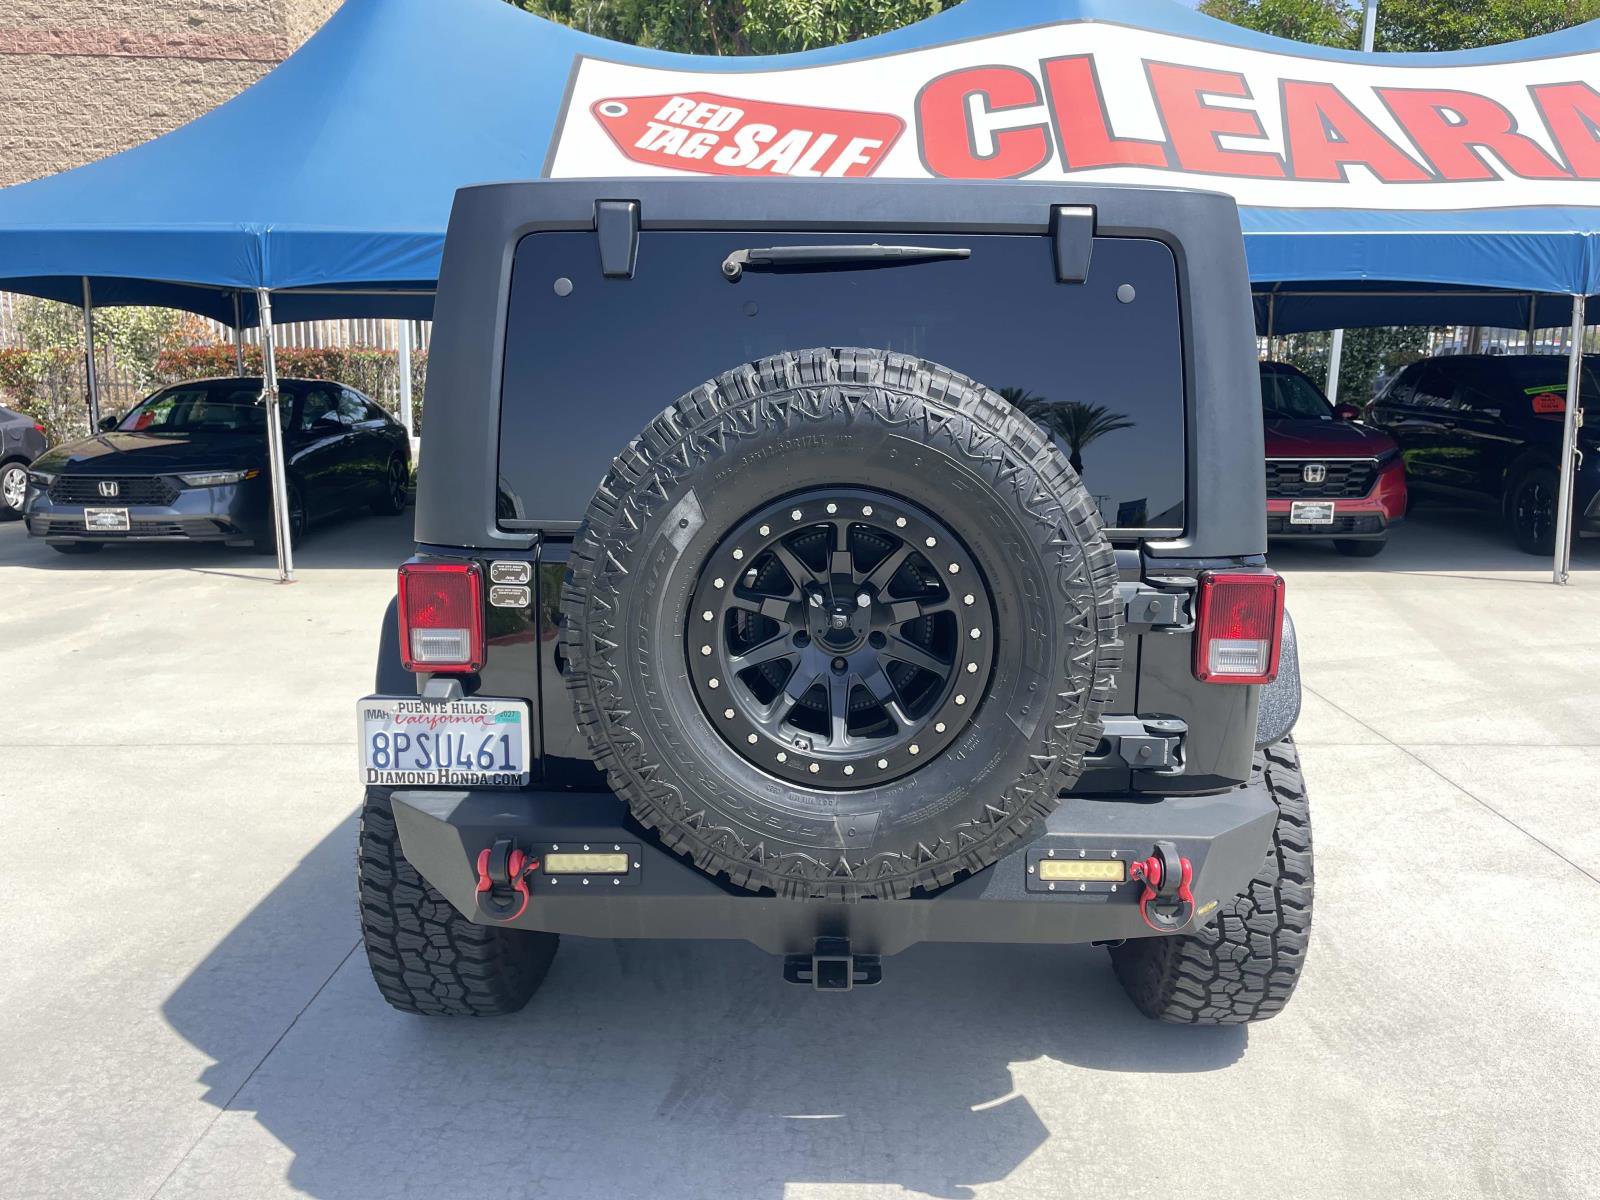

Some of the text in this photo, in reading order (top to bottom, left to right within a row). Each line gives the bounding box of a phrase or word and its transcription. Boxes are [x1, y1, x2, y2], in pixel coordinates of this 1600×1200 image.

[654, 96, 744, 132] RED
[634, 122, 719, 159] TAG
[398, 702, 488, 715] PUENTE HILLS
[372, 732, 517, 770] 8PSU461
